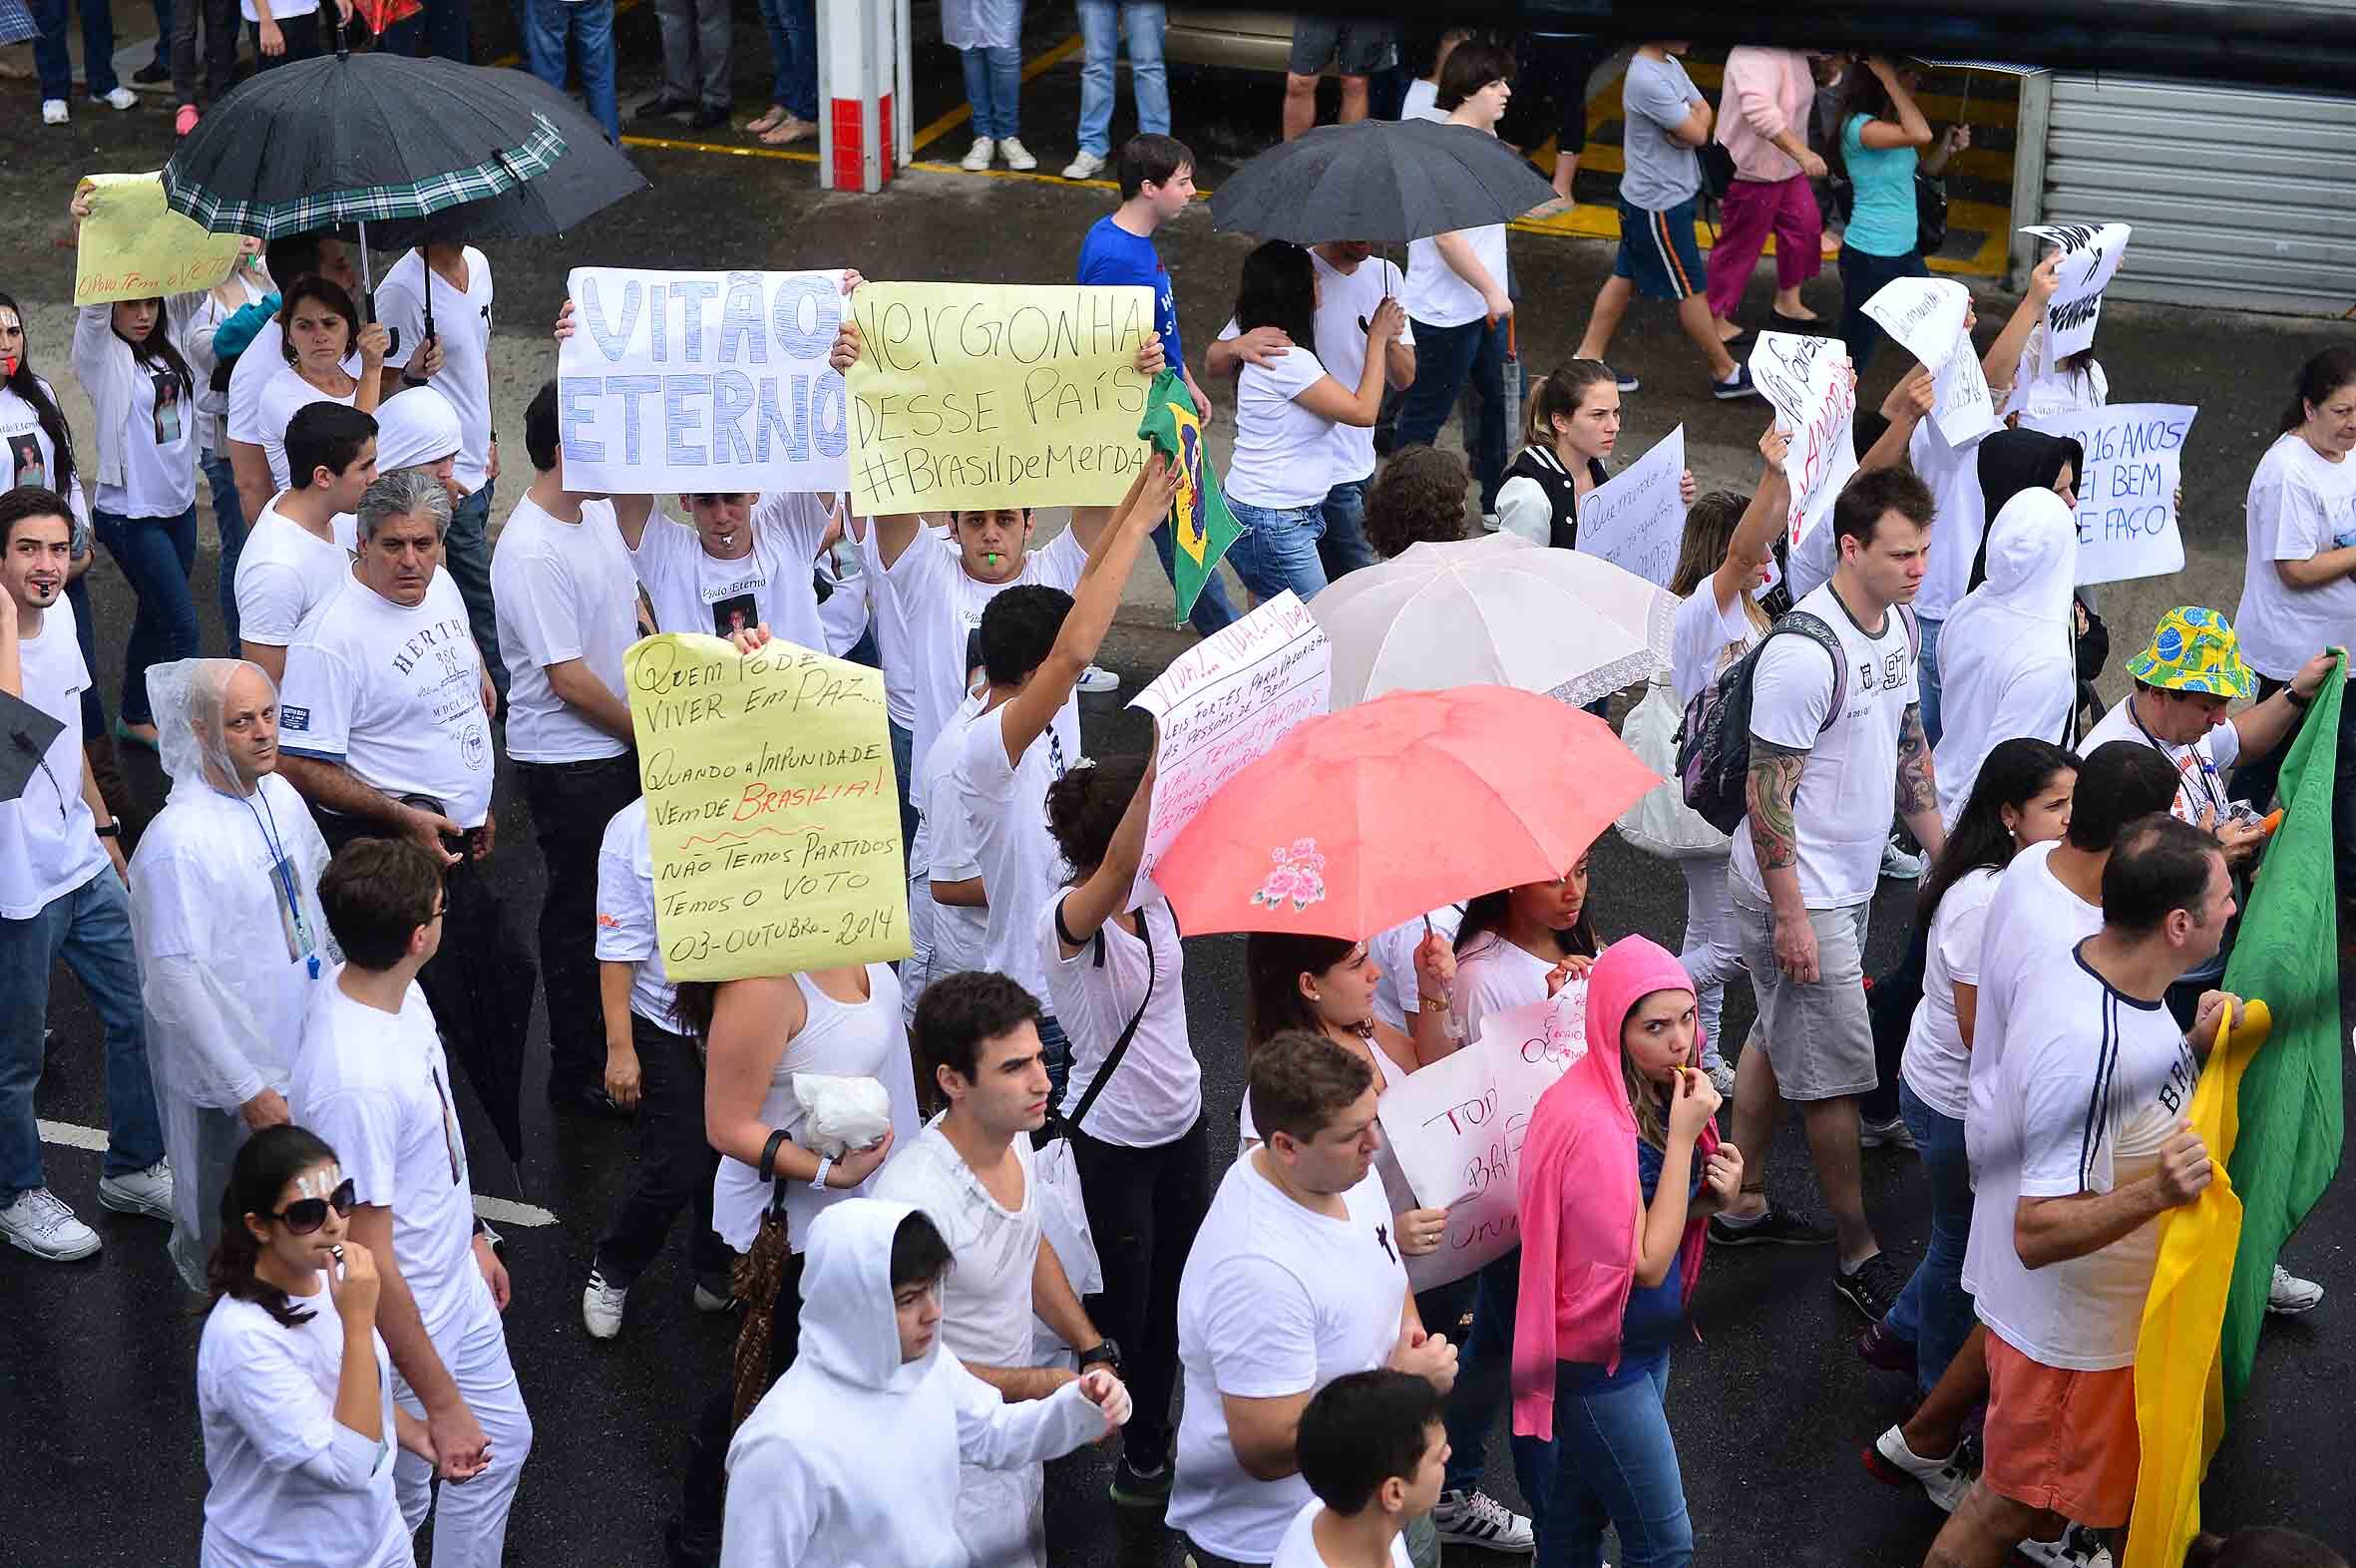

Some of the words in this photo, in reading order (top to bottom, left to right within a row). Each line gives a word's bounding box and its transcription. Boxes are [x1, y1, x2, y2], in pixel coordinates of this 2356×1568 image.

[583, 272, 842, 363] VITÃO
[562, 370, 848, 466] ETERNO
[855, 393, 998, 448] DESSE
[2090, 425, 2117, 462] 16
[2120, 421, 2185, 459] ANOS
[2075, 470, 2097, 503] EI
[2112, 462, 2162, 498] BEM
[2105, 505, 2166, 542] FAÇO
[729, 578, 766, 592] Eterno
[392, 618, 465, 677] HERTH
[634, 641, 723, 694] QUEM
[739, 645, 820, 682] PODE
[645, 693, 727, 733] VIVER
[1164, 717, 1189, 741] LEIS
[644, 748, 736, 791] QUANDO
[757, 741, 884, 778] IMPUNIDADE
[704, 798, 730, 818] DE
[733, 765, 884, 822] BRASILIA!
[661, 853, 711, 881] NÃO
[801, 832, 897, 868] PARTIDOS
[743, 889, 763, 907] O
[783, 871, 870, 901] VOTO
